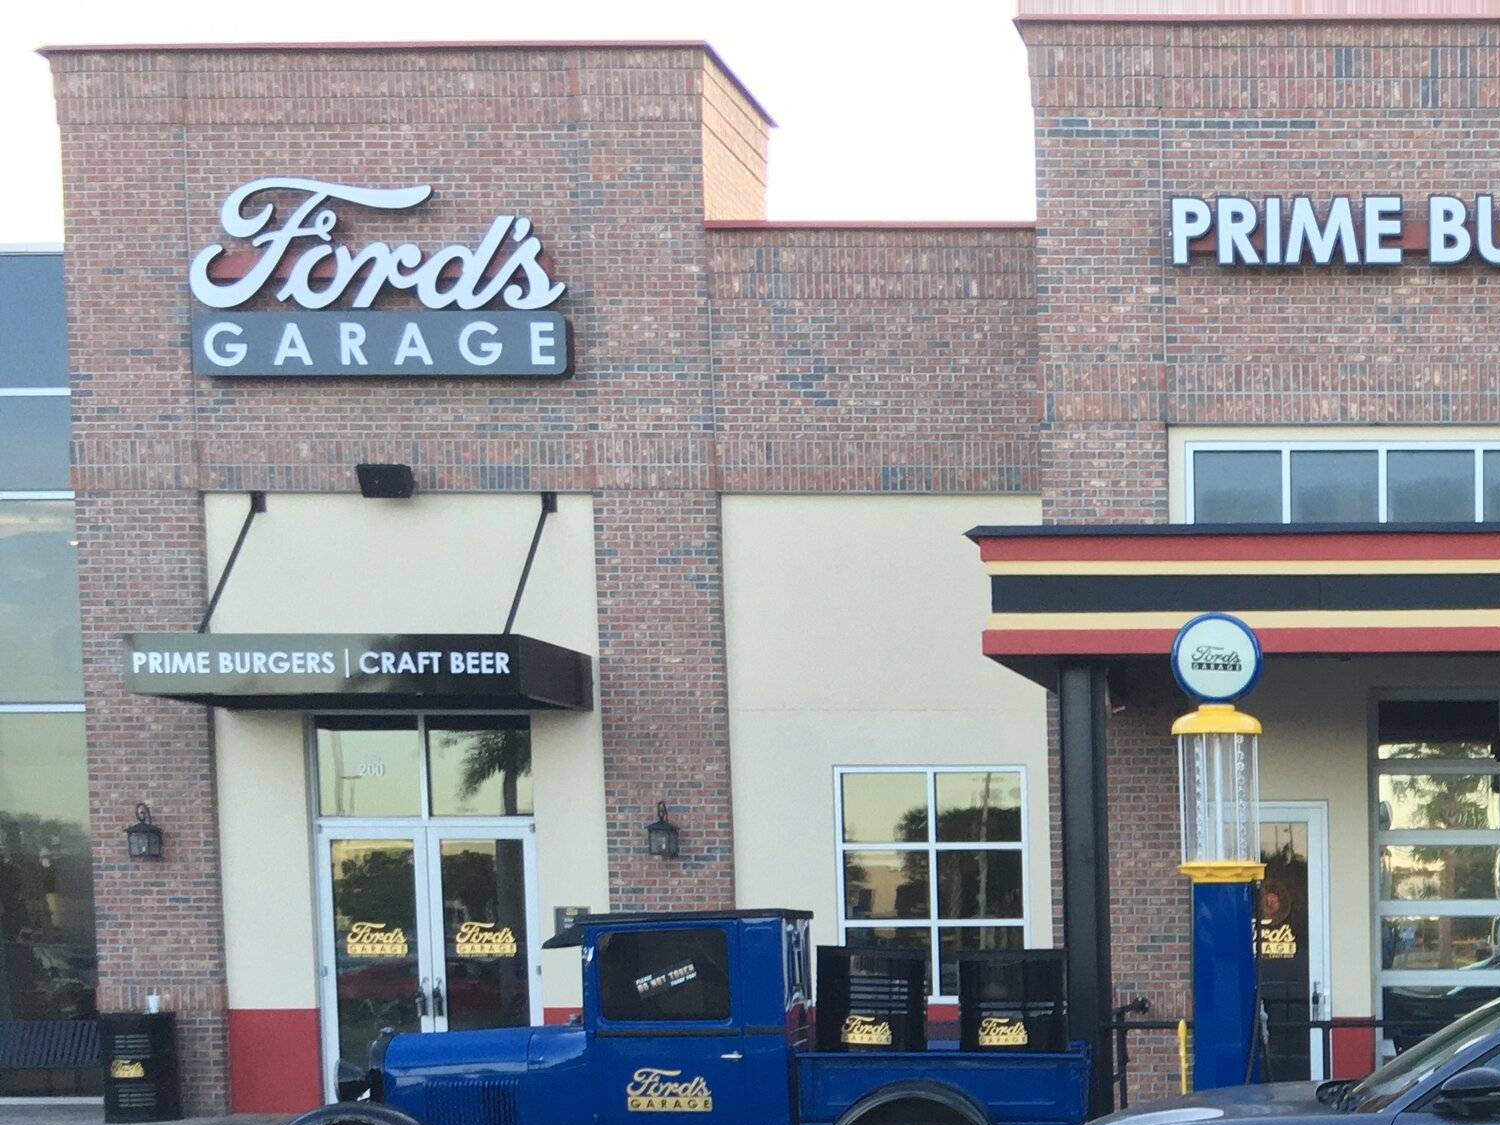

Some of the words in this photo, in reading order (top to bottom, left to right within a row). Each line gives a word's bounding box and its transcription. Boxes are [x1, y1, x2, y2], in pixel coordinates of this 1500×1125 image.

[1170, 195, 1402, 265] PRIME
[190, 178, 566, 310] Ford's
[203, 321, 556, 367] GARAGE
[132, 651, 210, 674] PRIME
[218, 651, 335, 675] BURGERS
[359, 651, 442, 674] CRAFT
[450, 651, 511, 674] BEER
[1191, 645, 1241, 662] Ford's
[347, 921, 407, 943] Ford's
[456, 921, 516, 943] Ford's
[349, 944, 407, 953] GARAGE
[458, 944, 515, 953] GARAGE
[841, 1015, 892, 1035] Ford's
[979, 1018, 1027, 1036] Ford's
[627, 1067, 712, 1097] Ford's
[630, 1099, 711, 1109] GARAGE
